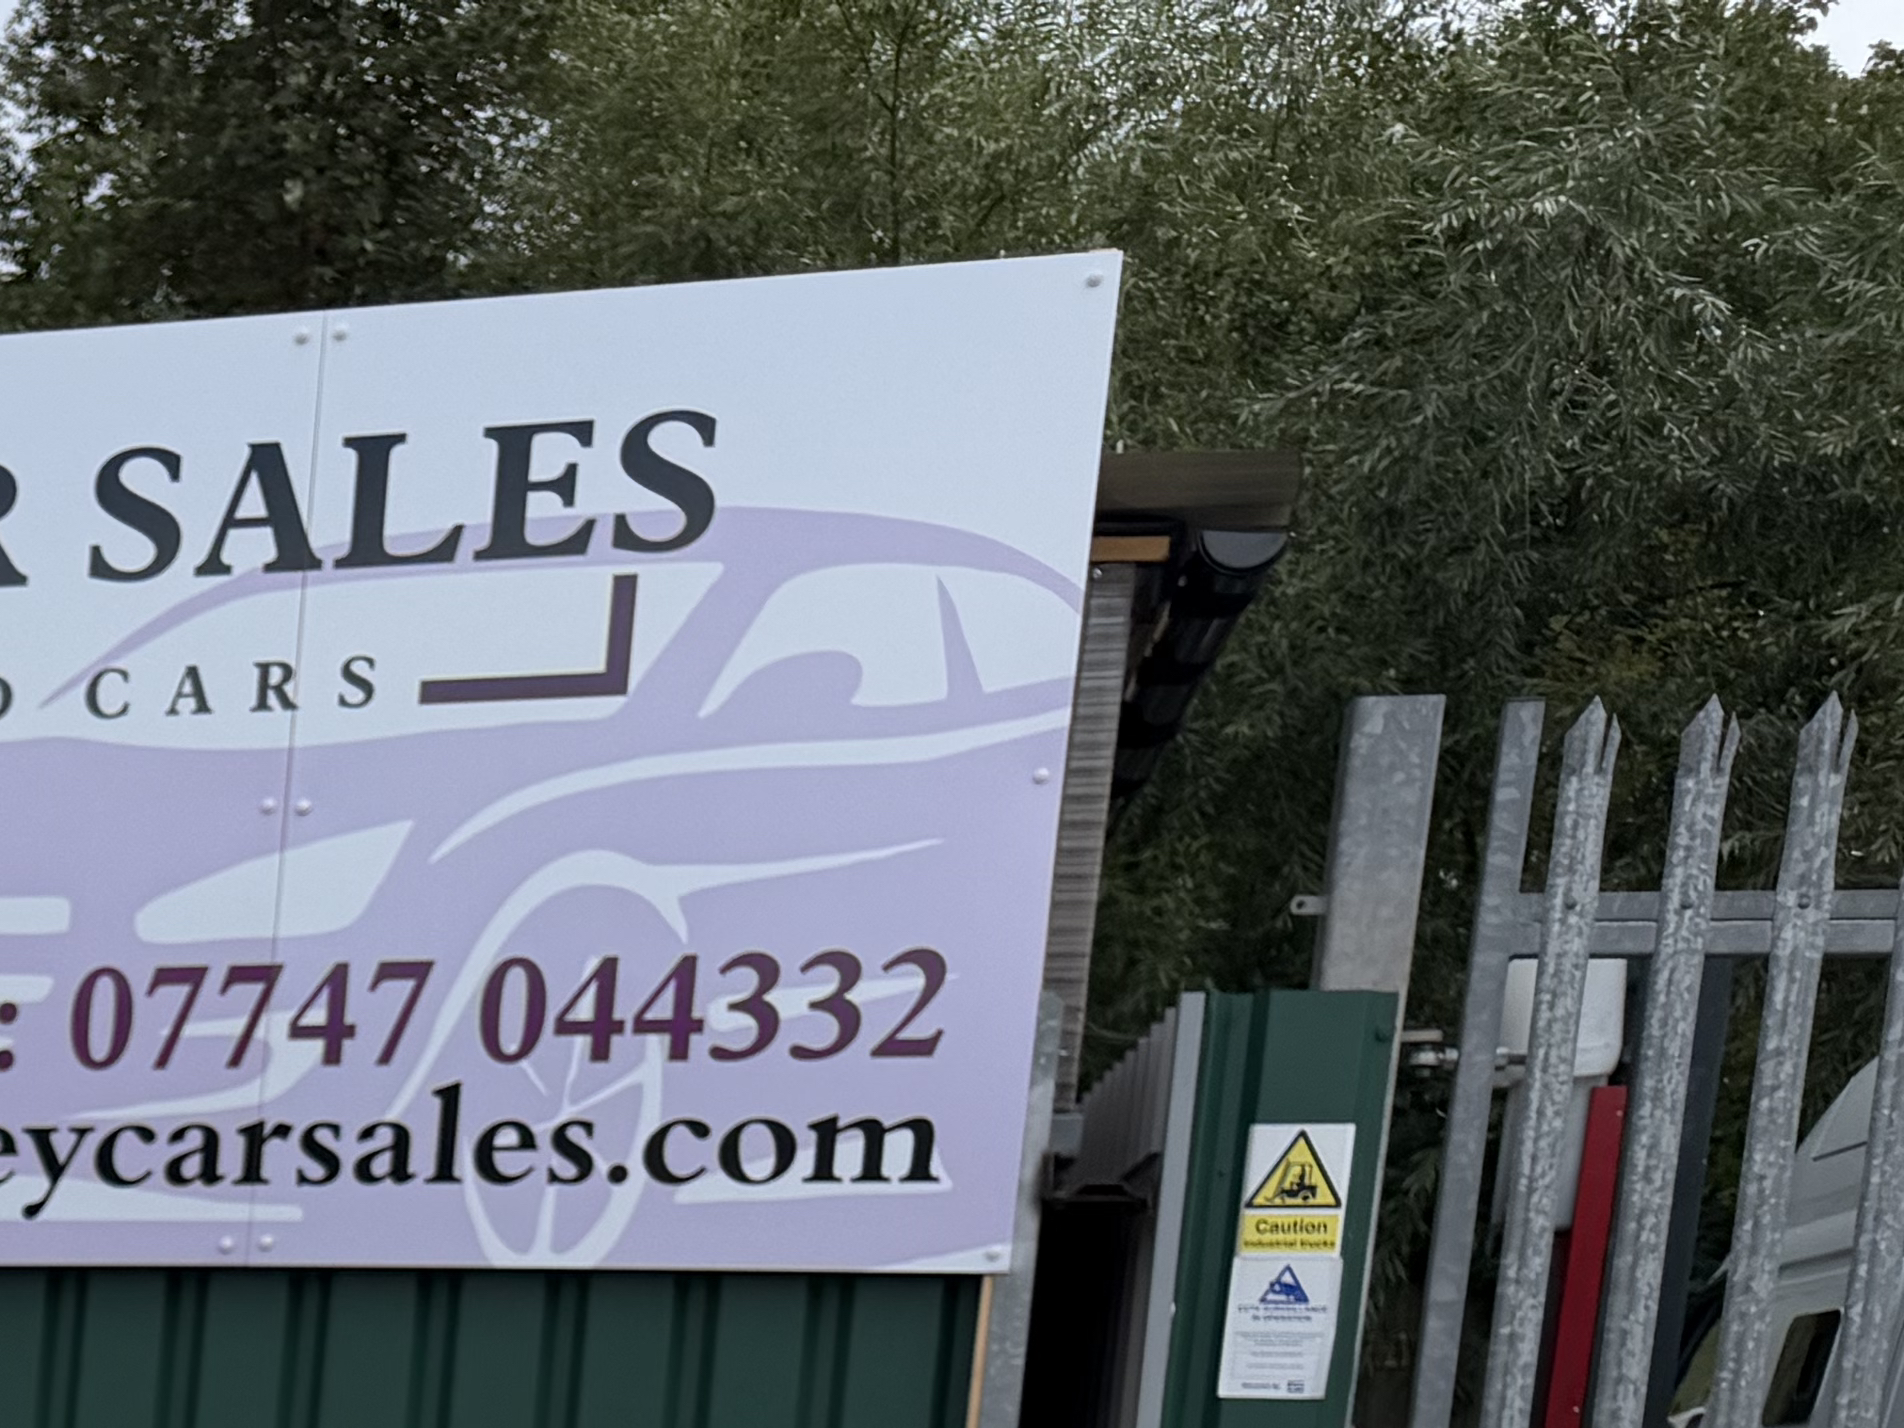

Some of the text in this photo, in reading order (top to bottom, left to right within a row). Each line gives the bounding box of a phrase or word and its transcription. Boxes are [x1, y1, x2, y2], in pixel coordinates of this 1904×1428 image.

[87, 409, 717, 583] SALES
[85, 655, 376, 719] CARS
[70, 960, 435, 1071] 07747
[479, 948, 948, 1064] 044332
[1255, 1218, 1328, 1235] Caution
